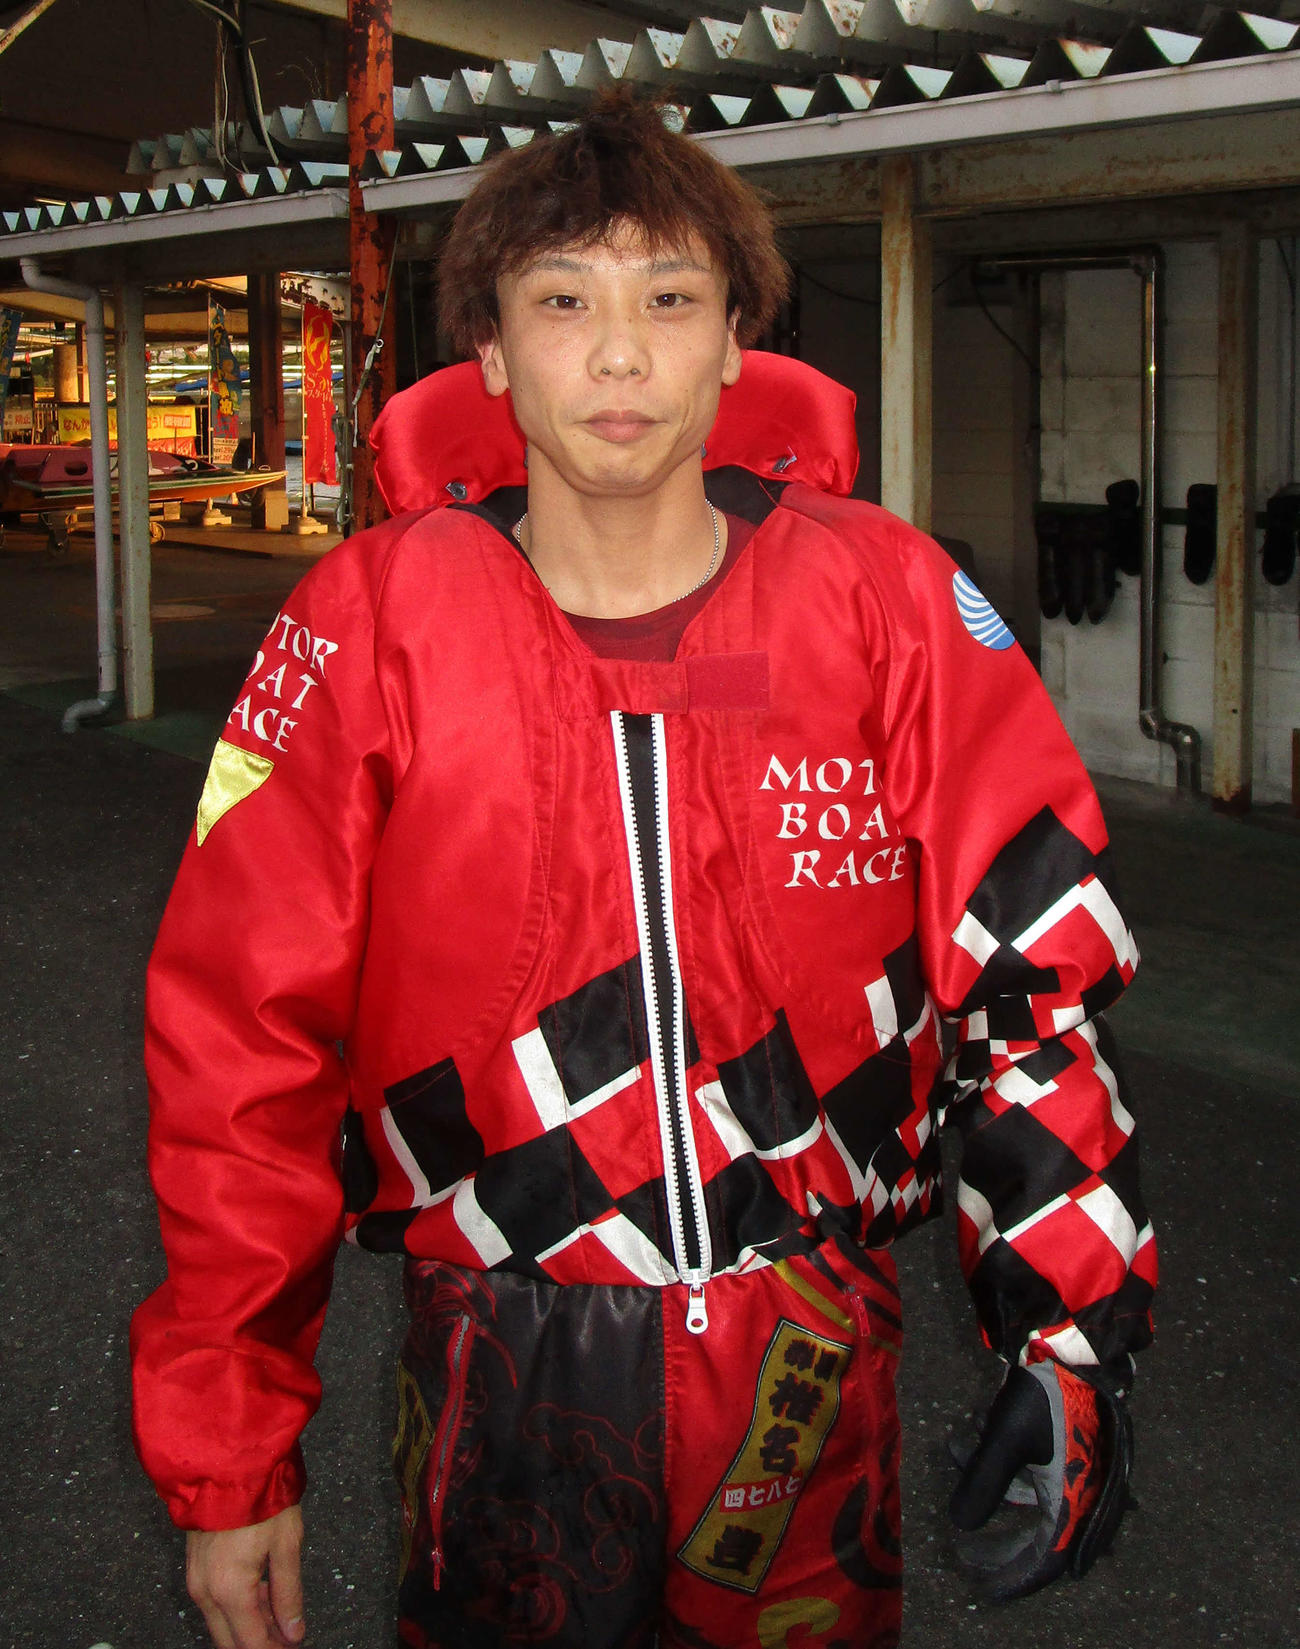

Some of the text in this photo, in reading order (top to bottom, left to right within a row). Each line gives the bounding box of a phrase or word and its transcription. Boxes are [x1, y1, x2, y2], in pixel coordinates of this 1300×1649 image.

[758, 753, 884, 796] MOT
[776, 802, 901, 841] BOA
[783, 844, 906, 890] RACE
